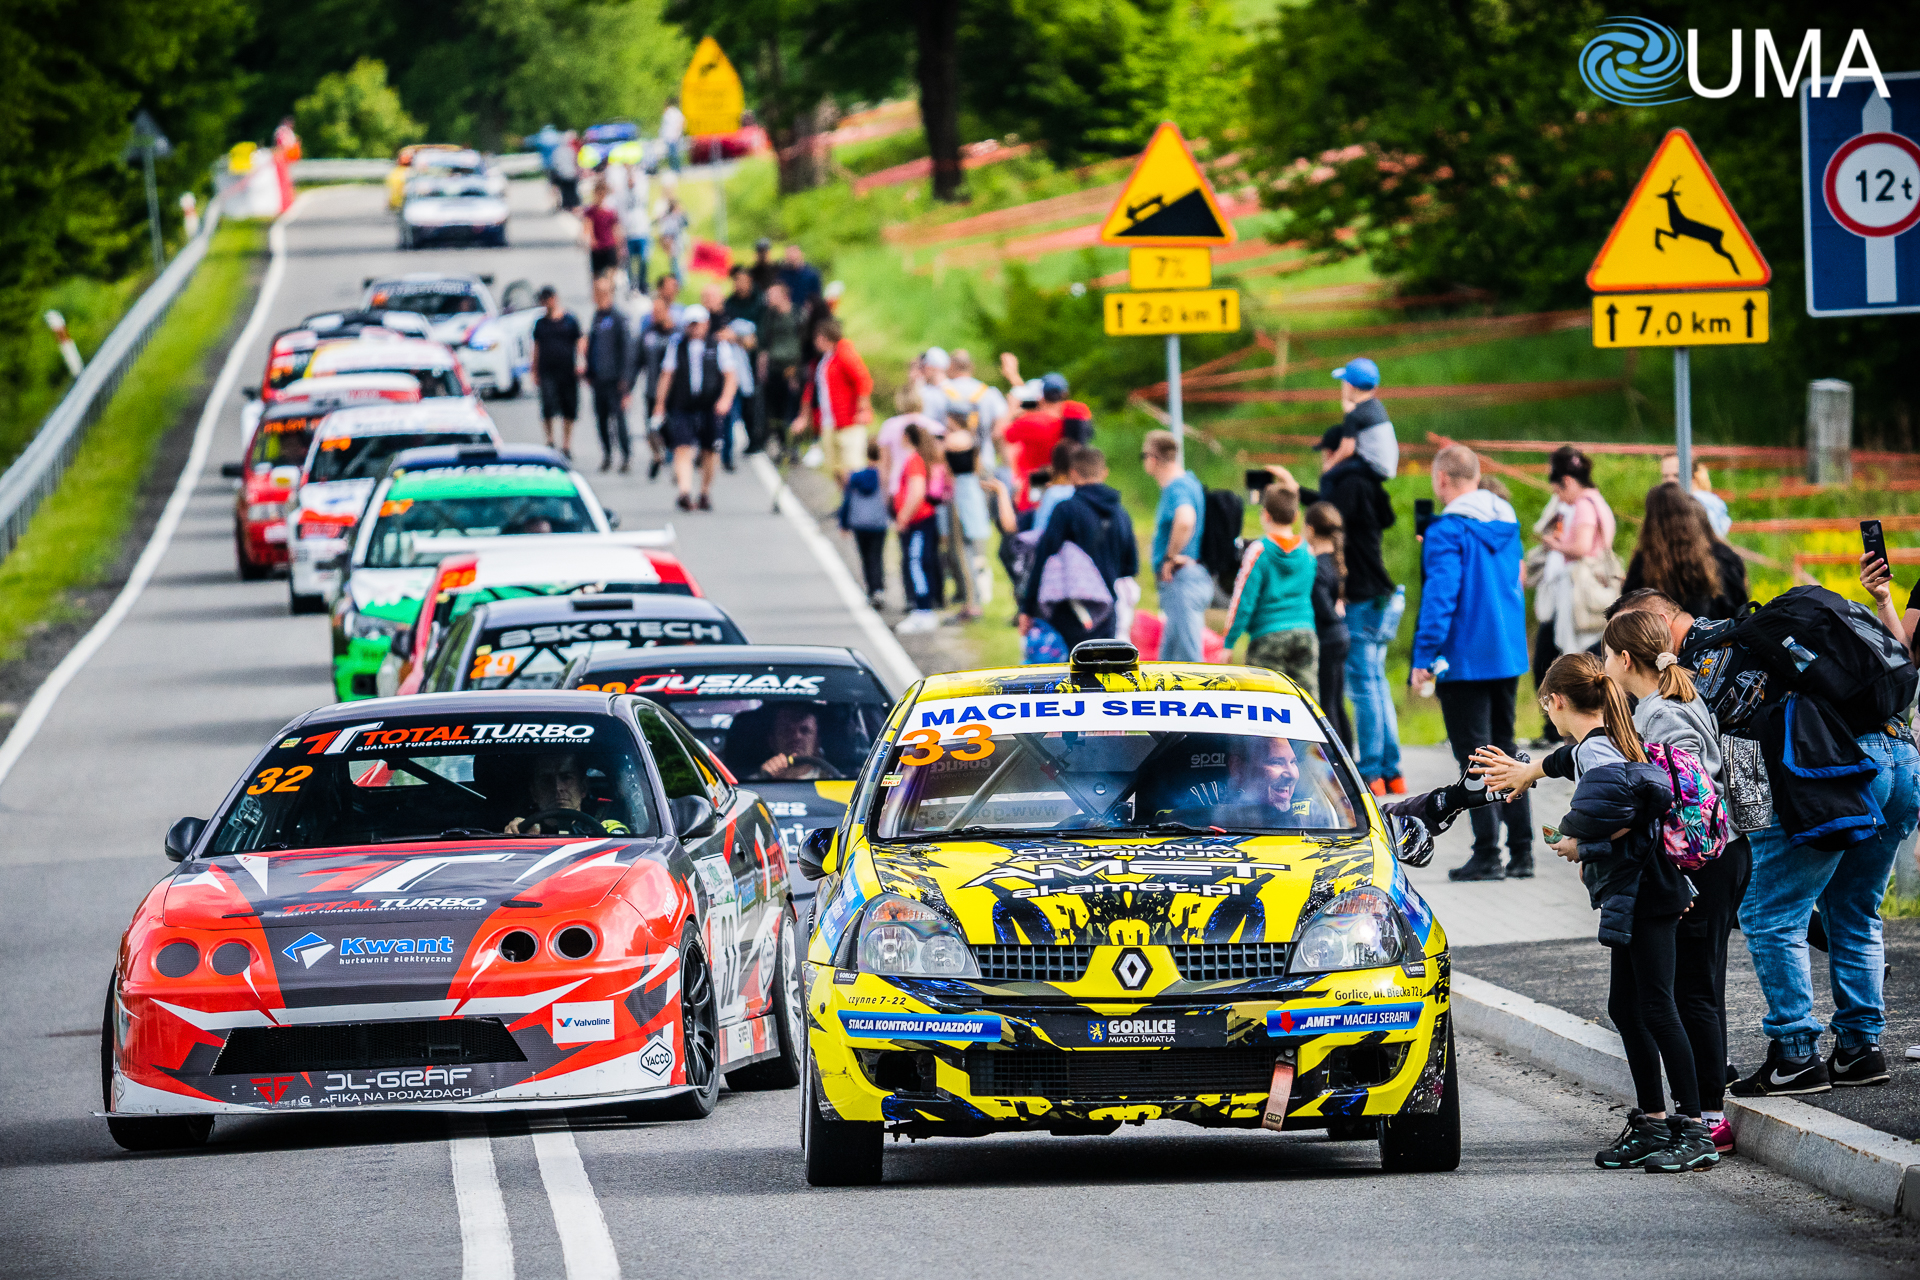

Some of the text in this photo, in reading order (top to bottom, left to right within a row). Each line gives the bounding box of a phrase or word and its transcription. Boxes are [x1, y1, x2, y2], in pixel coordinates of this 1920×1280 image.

[1180, 303, 1210, 323] km
[1636, 304, 1731, 339] 7,0 km
[613, 620, 724, 643] TECH
[469, 653, 516, 680] 29
[635, 673, 826, 694] JUSIAK
[921, 699, 1292, 728] MACIEJ SERAFIN
[355, 742, 403, 752] QUALITY
[404, 738, 493, 750] TURBOCHARGER
[898, 723, 997, 767] 33
[246, 765, 314, 796] 32
[1007, 850, 1243, 864] ALUMINIUM
[1016, 844, 1233, 856] ODLEWNIA
[960, 859, 1290, 888] AMET
[1012, 881, 1241, 898] al-amet.pl
[339, 936, 454, 956] Kwant
[339, 954, 453, 965] hurtownie elektryczne
[848, 995, 877, 1006] czynne
[1335, 988, 1371, 1001] Gorlice,
[1373, 988, 1386, 998] ul.
[1387, 987, 1411, 998] Biecka
[573, 1017, 611, 1027] Valvoline
[848, 1018, 984, 1033] STACJA KONTROLI POJAZDÓW
[1343, 1012, 1378, 1026] MACIEJ
[1379, 1011, 1410, 1024] SERAFIN
[1108, 1019, 1176, 1034] GORLICE
[1141, 1034, 1176, 1043] ŚWIATŁA
[644, 1053, 670, 1067] YACCO
[364, 1091, 384, 1102] NA
[386, 1087, 473, 1100] POJAZDACH
